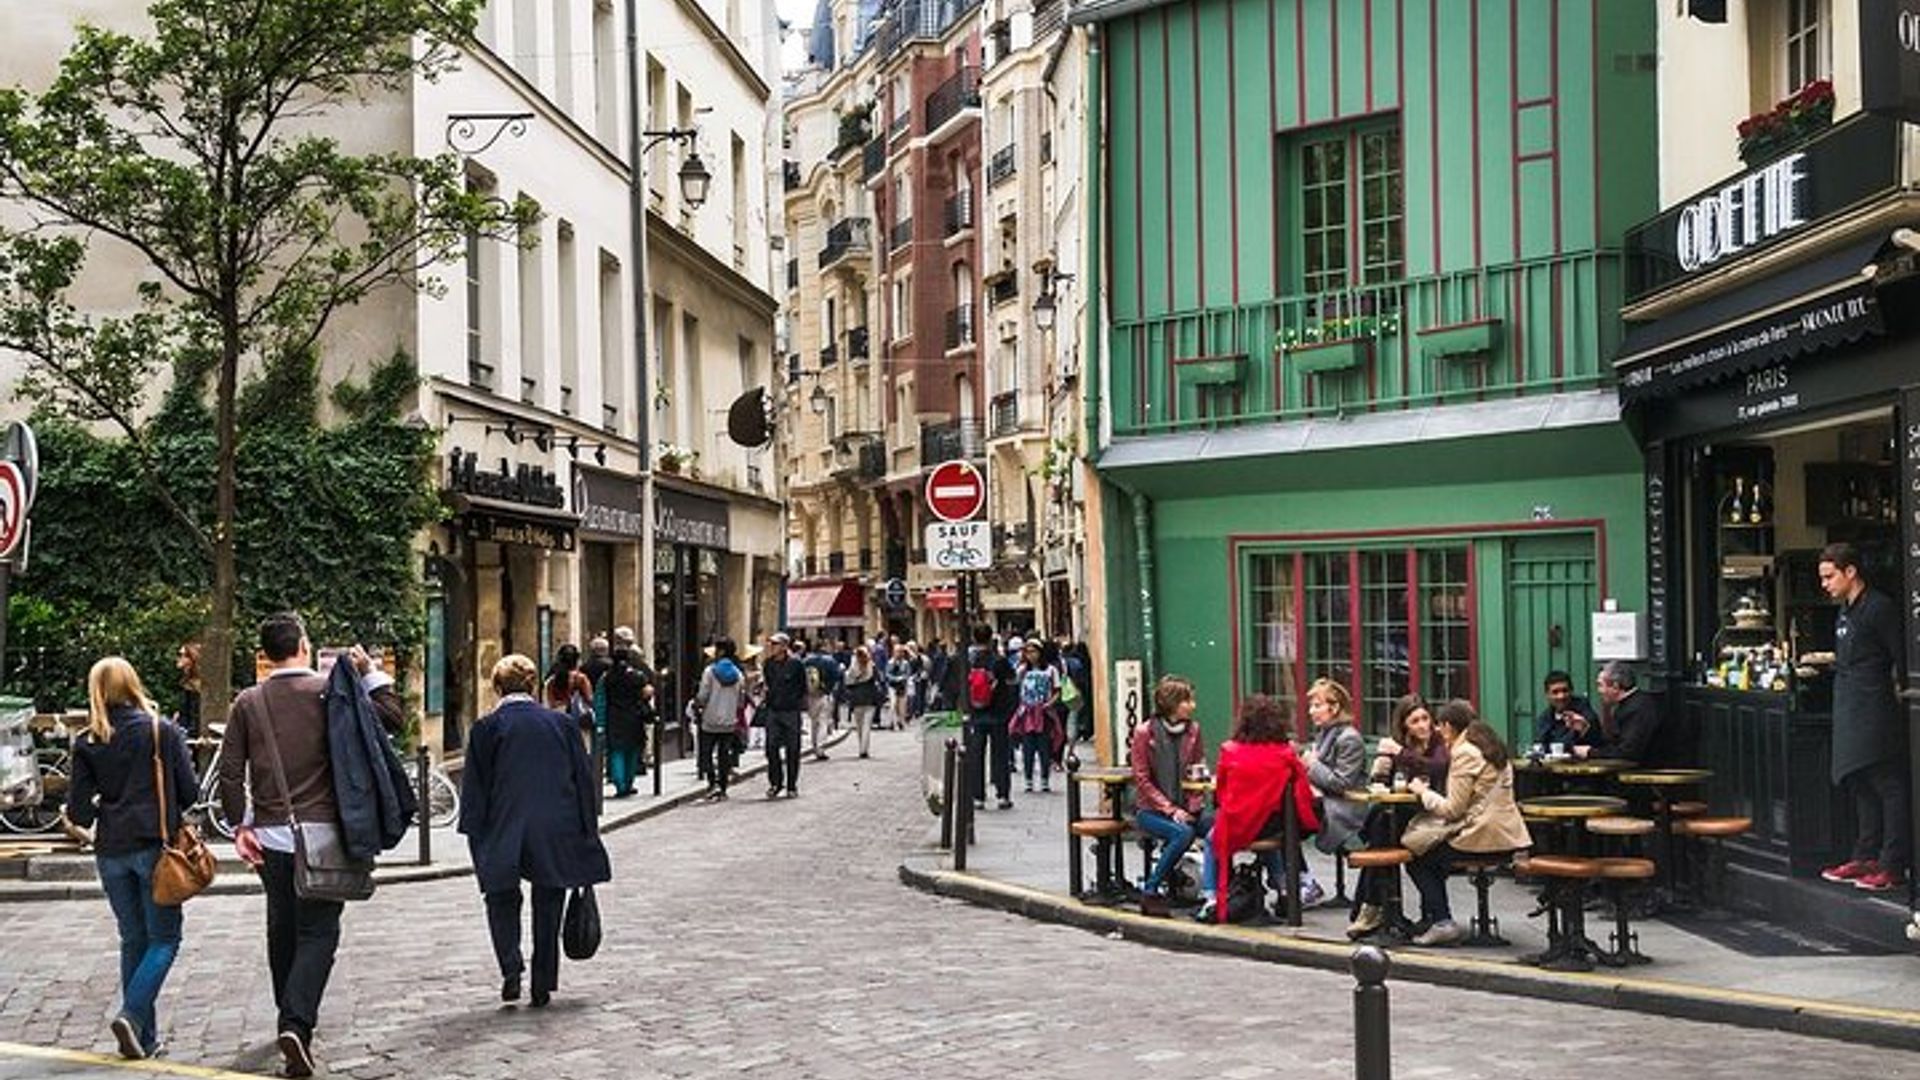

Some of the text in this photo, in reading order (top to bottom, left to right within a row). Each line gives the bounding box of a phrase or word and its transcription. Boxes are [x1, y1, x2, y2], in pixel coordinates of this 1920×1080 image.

[1677, 152, 1808, 272] ODETTE
[1747, 366, 1788, 396] PARIS
[938, 524, 979, 538] SAUF
